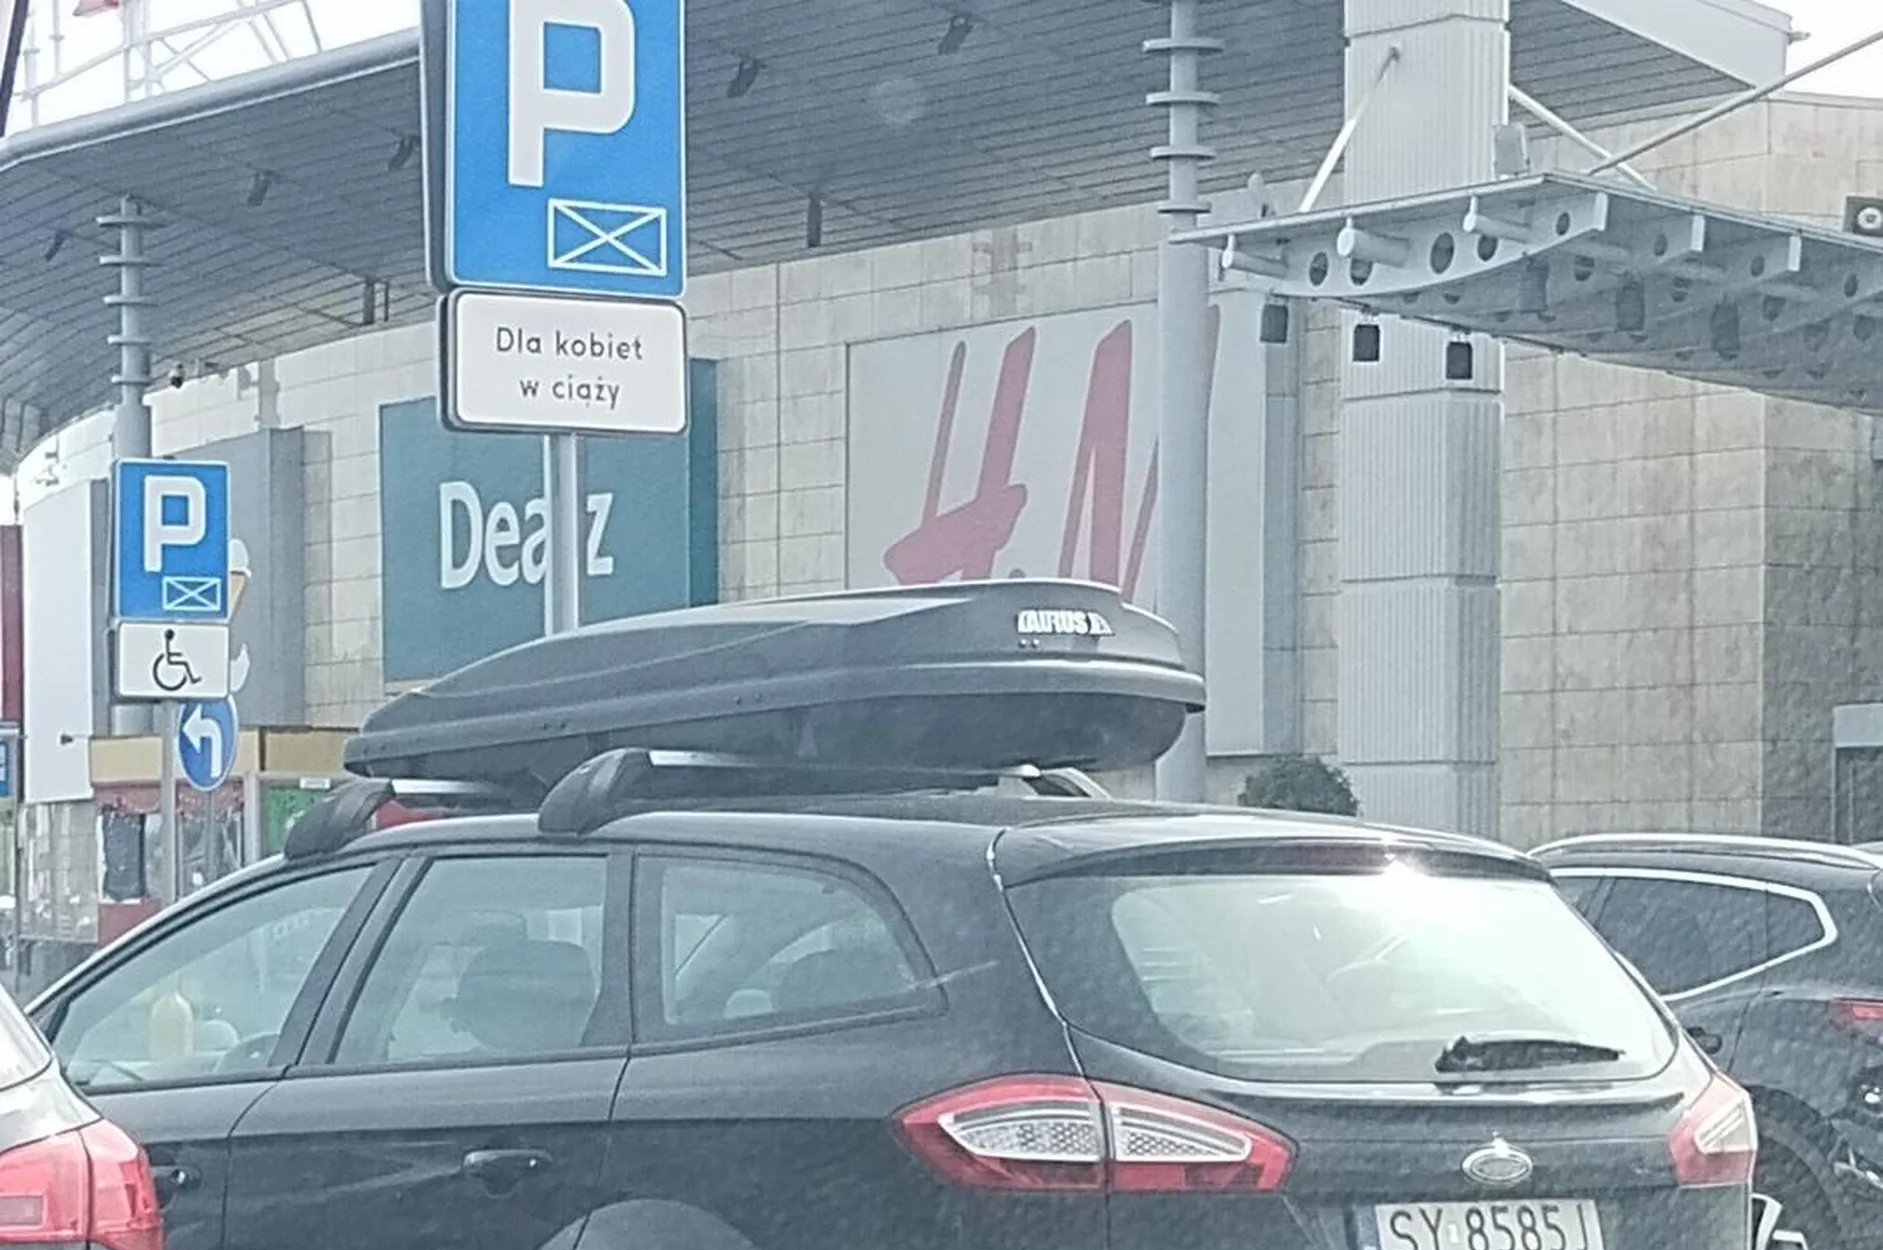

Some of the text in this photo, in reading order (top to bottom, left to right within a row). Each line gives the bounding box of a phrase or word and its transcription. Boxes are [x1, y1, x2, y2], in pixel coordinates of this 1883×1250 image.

[508, 0, 635, 187] P
[496, 326, 643, 360] Dla kobiet
[519, 373, 620, 411] w ciąży
[144, 475, 207, 572] P
[439, 481, 614, 589] Deaz
